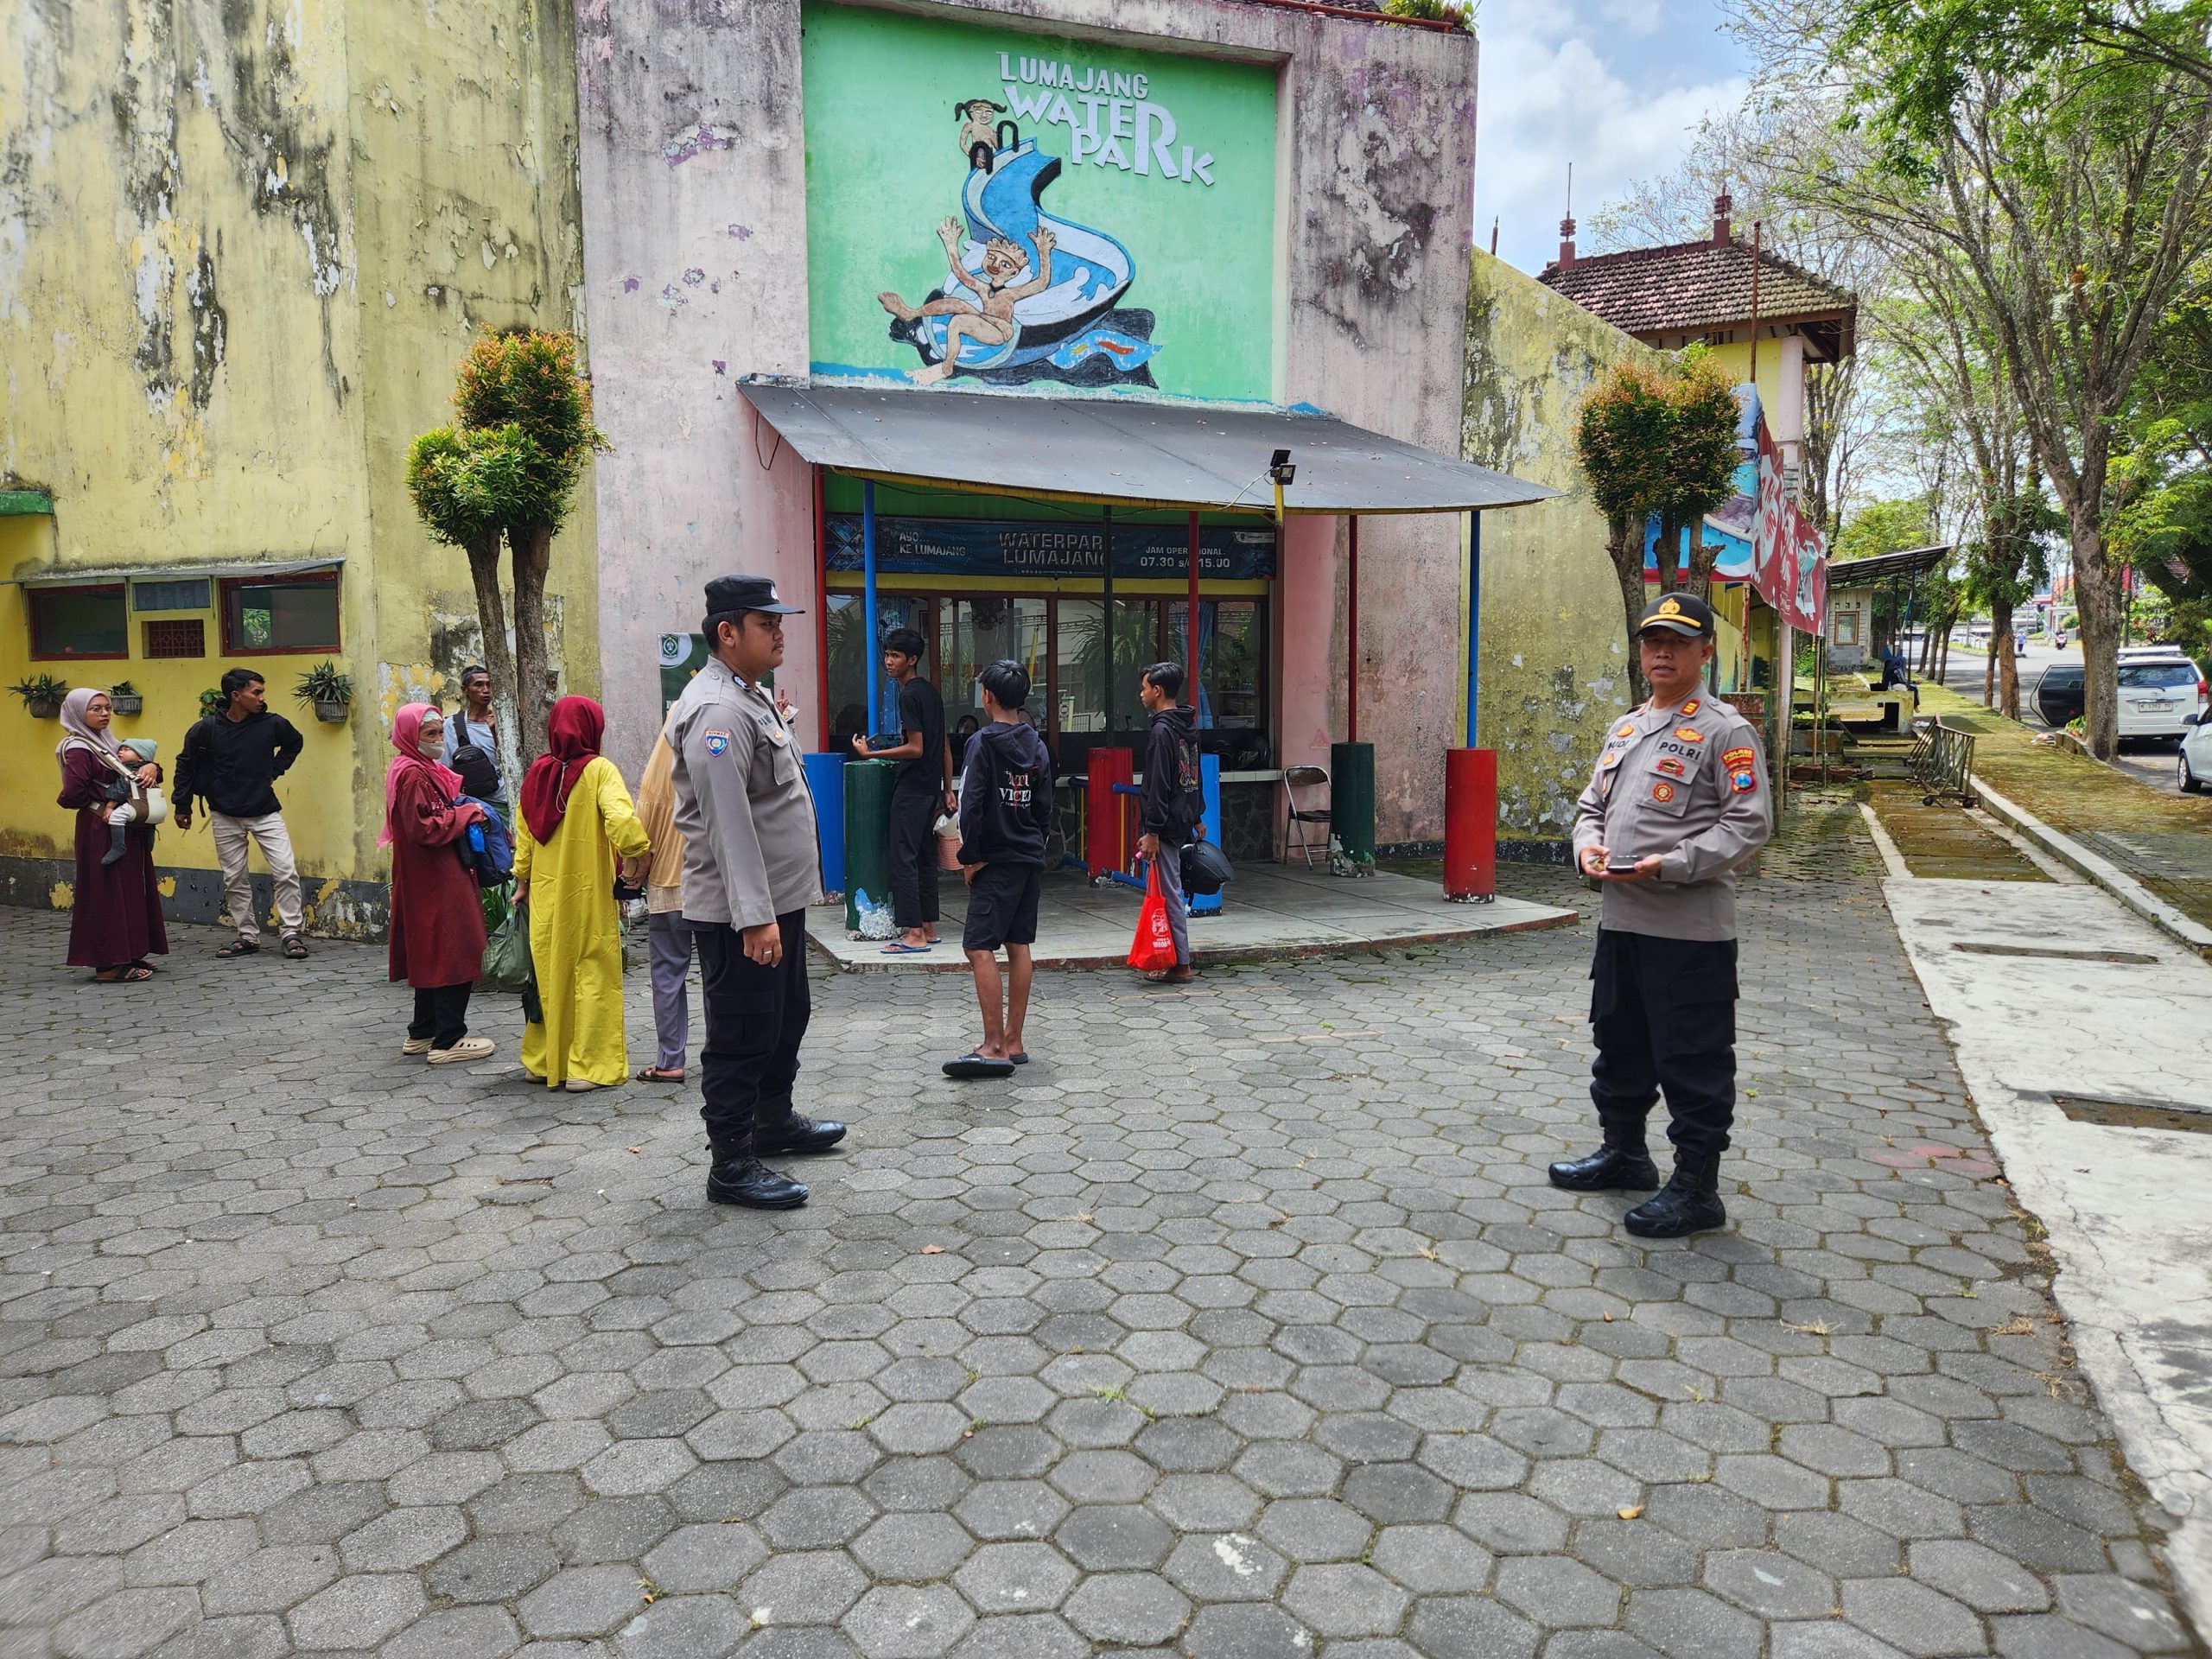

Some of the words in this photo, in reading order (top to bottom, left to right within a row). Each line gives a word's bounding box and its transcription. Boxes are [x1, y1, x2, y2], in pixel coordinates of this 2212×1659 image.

[999, 52, 1148, 99] LUMAJANG
[1003, 86, 1179, 179] WATER
[899, 543, 912, 554] KE
[915, 544, 966, 556] LUMAJANG
[1166, 547, 1226, 556] OPERIONAL.
[1140, 556, 1174, 567] 07.30
[1659, 741, 1701, 760] POLRI
